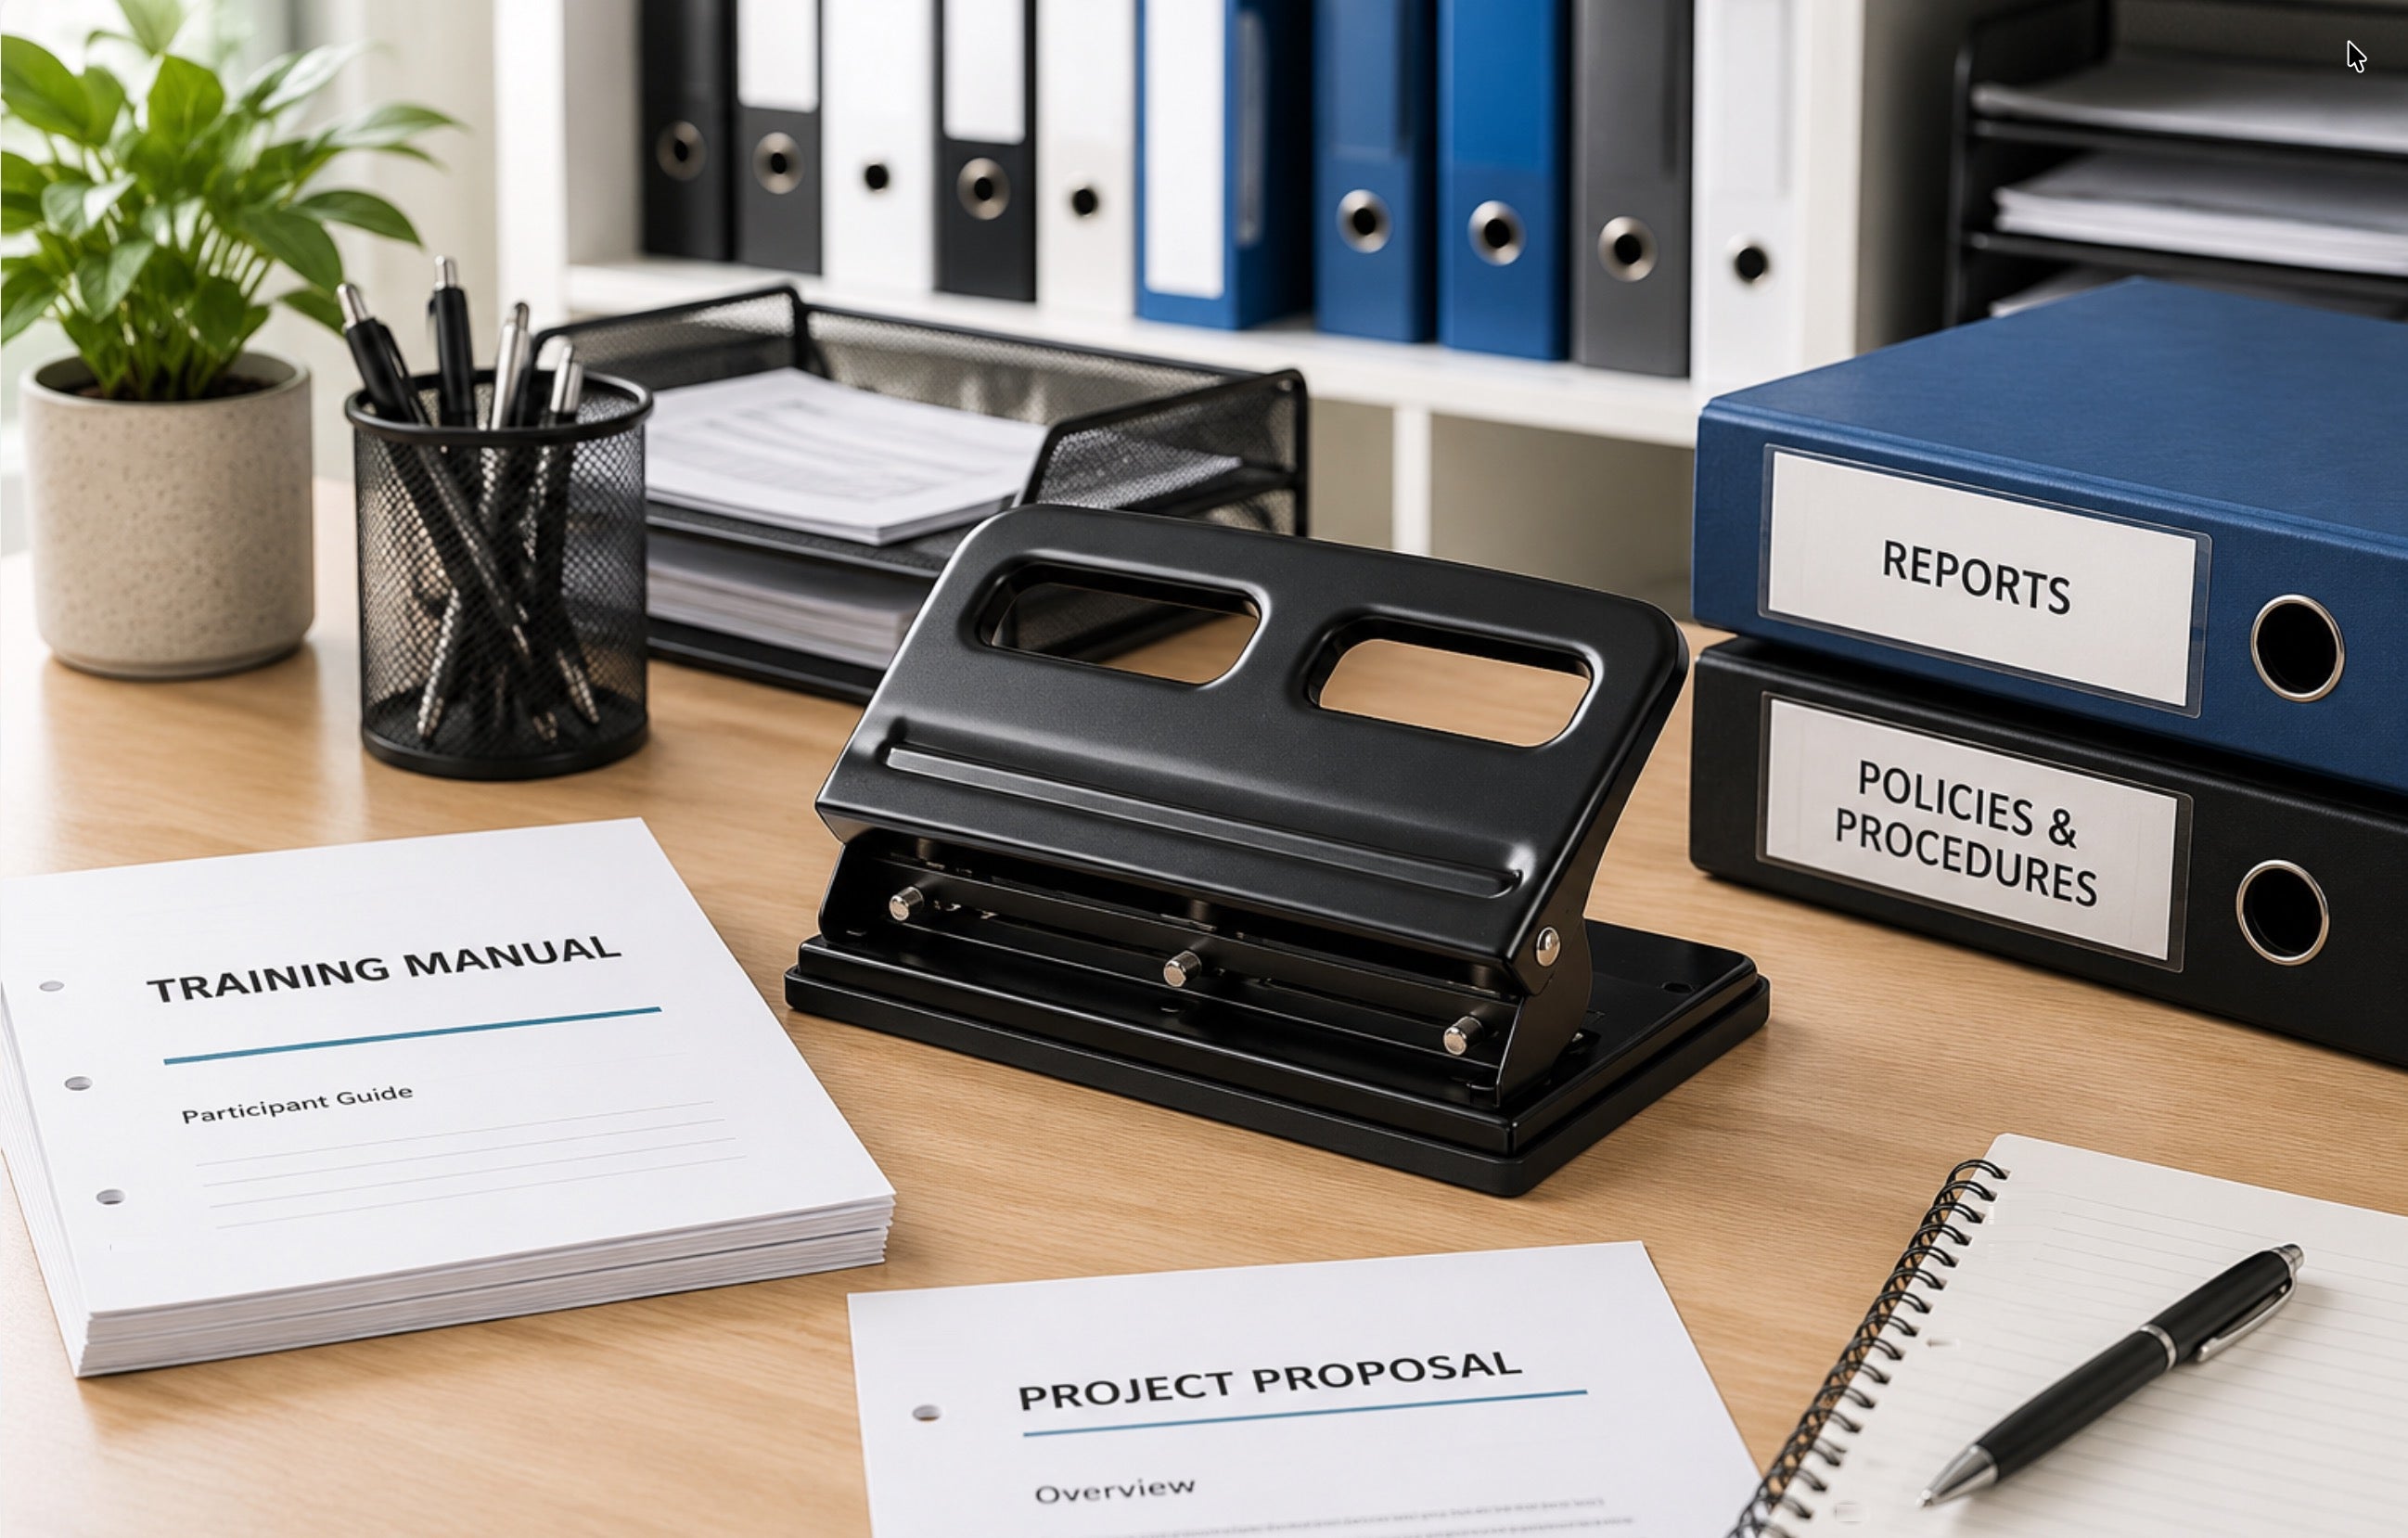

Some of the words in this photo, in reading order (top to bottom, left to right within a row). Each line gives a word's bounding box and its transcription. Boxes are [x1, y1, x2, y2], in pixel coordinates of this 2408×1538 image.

[1882, 539, 2071, 616] REPORTS
[1858, 759, 2034, 838] POLICIES
[2047, 808, 2078, 850] &
[1836, 806, 2098, 908] PROCEDURES
[146, 956, 391, 1004] TRAINING
[403, 934, 622, 978] MANUAL
[181, 1094, 328, 1125] Participant
[335, 1085, 414, 1106] Guide
[1019, 1370, 1234, 1412] PROJECT
[1251, 1350, 1523, 1394] PROPOSAL
[1034, 1479, 1197, 1504] Overview
